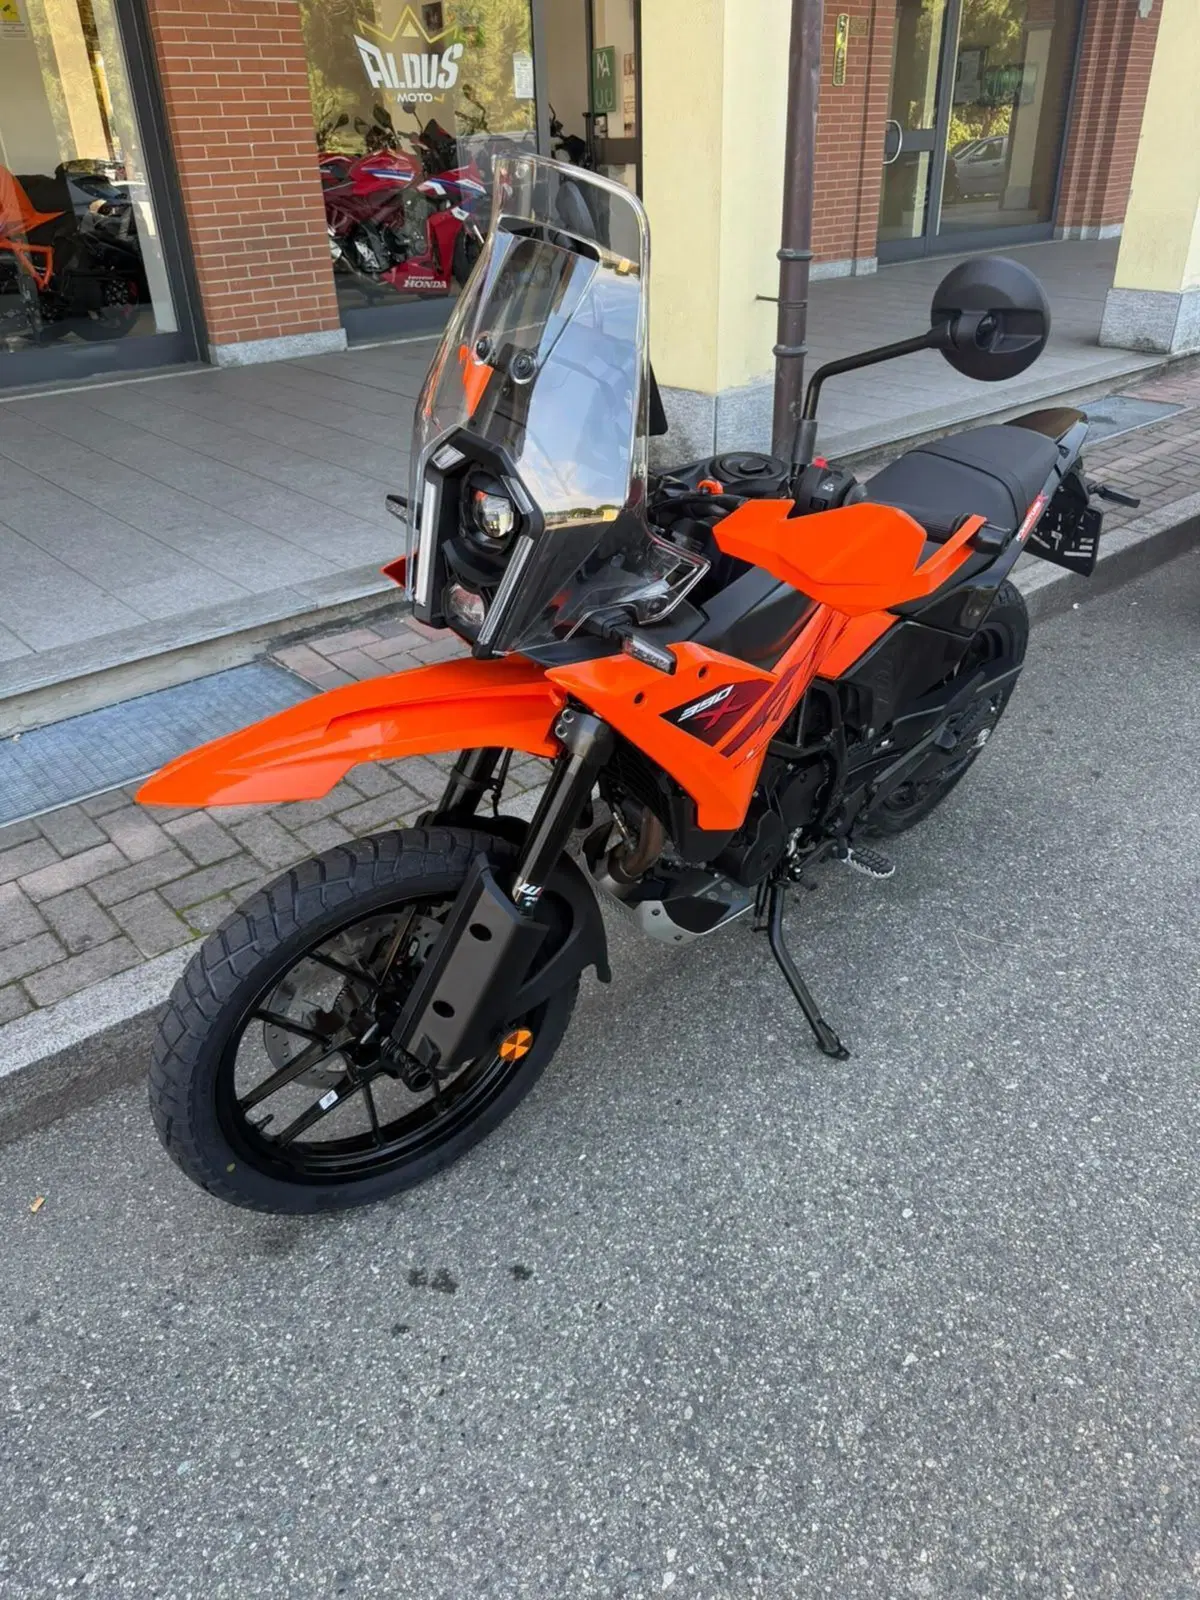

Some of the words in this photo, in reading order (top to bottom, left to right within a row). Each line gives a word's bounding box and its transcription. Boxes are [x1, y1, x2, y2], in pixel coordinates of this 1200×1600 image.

[353, 34, 464, 88] ALDUS
[397, 92, 433, 103] MOTO
[403, 280, 447, 289] HONDA
[677, 684, 735, 722] 390
